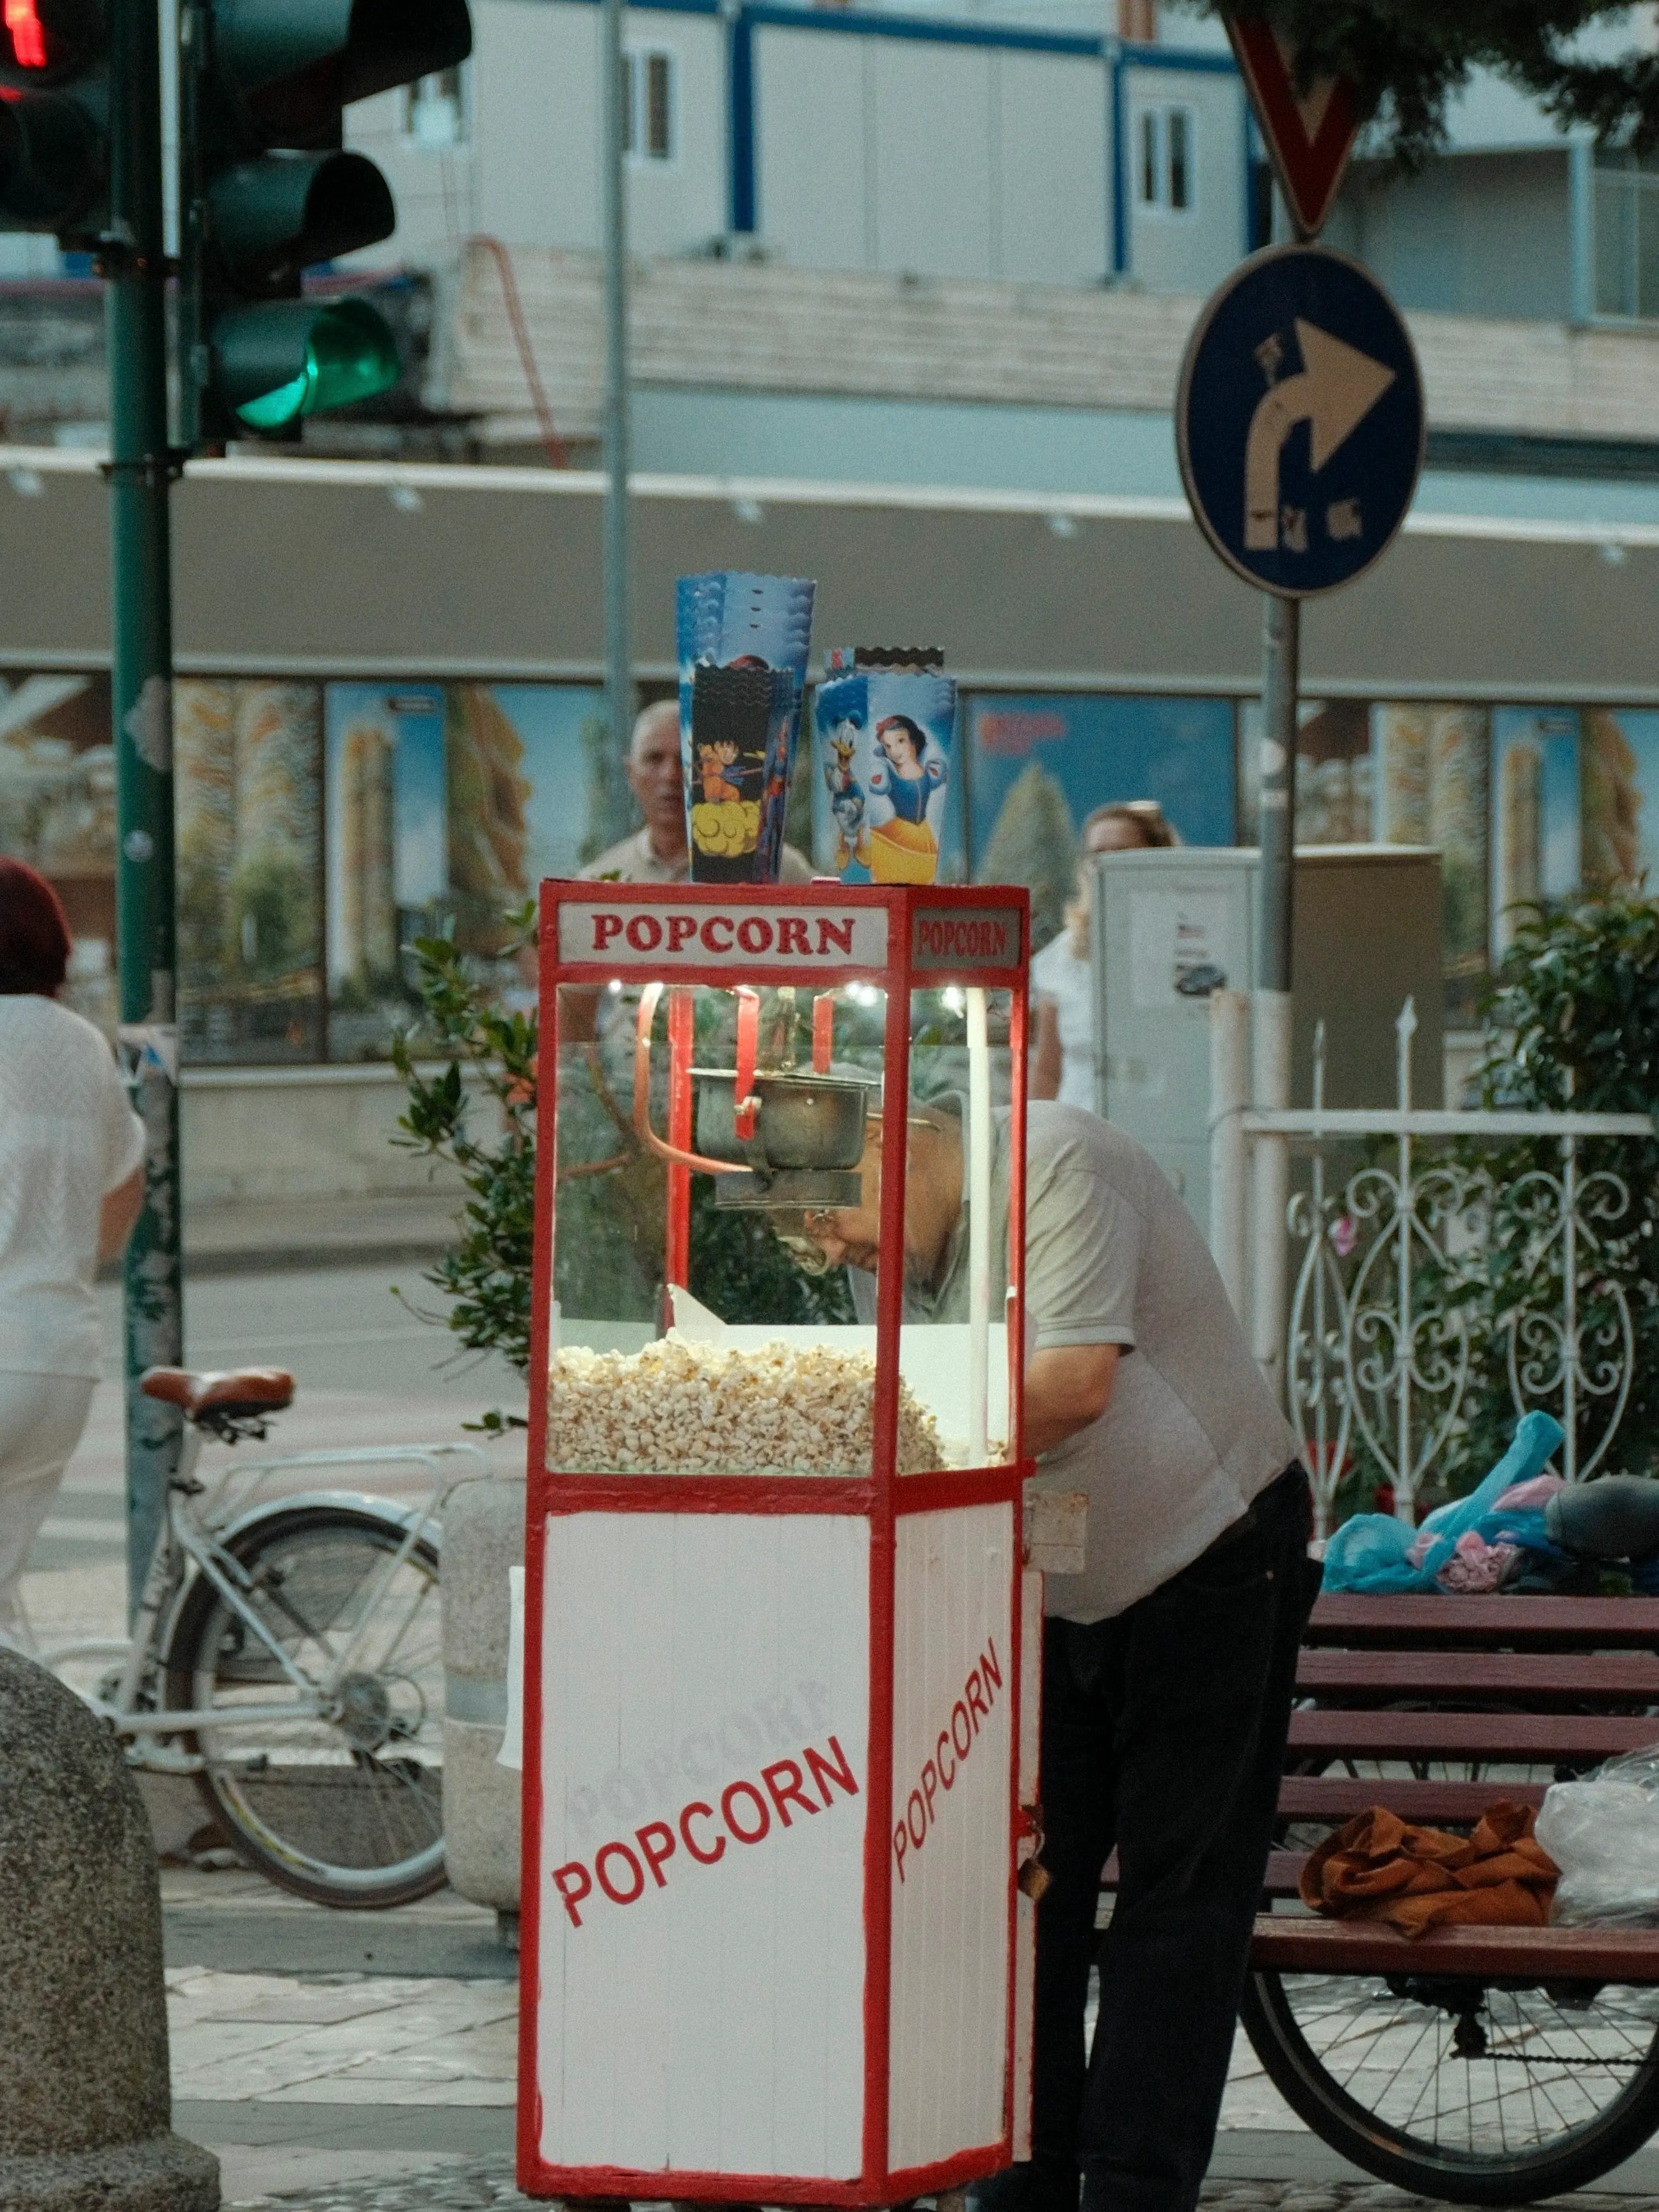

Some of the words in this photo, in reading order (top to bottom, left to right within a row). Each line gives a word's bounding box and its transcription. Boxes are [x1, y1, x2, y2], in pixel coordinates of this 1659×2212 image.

[593, 914, 854, 955] POPCORN
[917, 920, 1007, 957] POPCORN
[894, 1635, 1003, 1883] POPCORN
[551, 1735, 860, 1928] POPCORN
